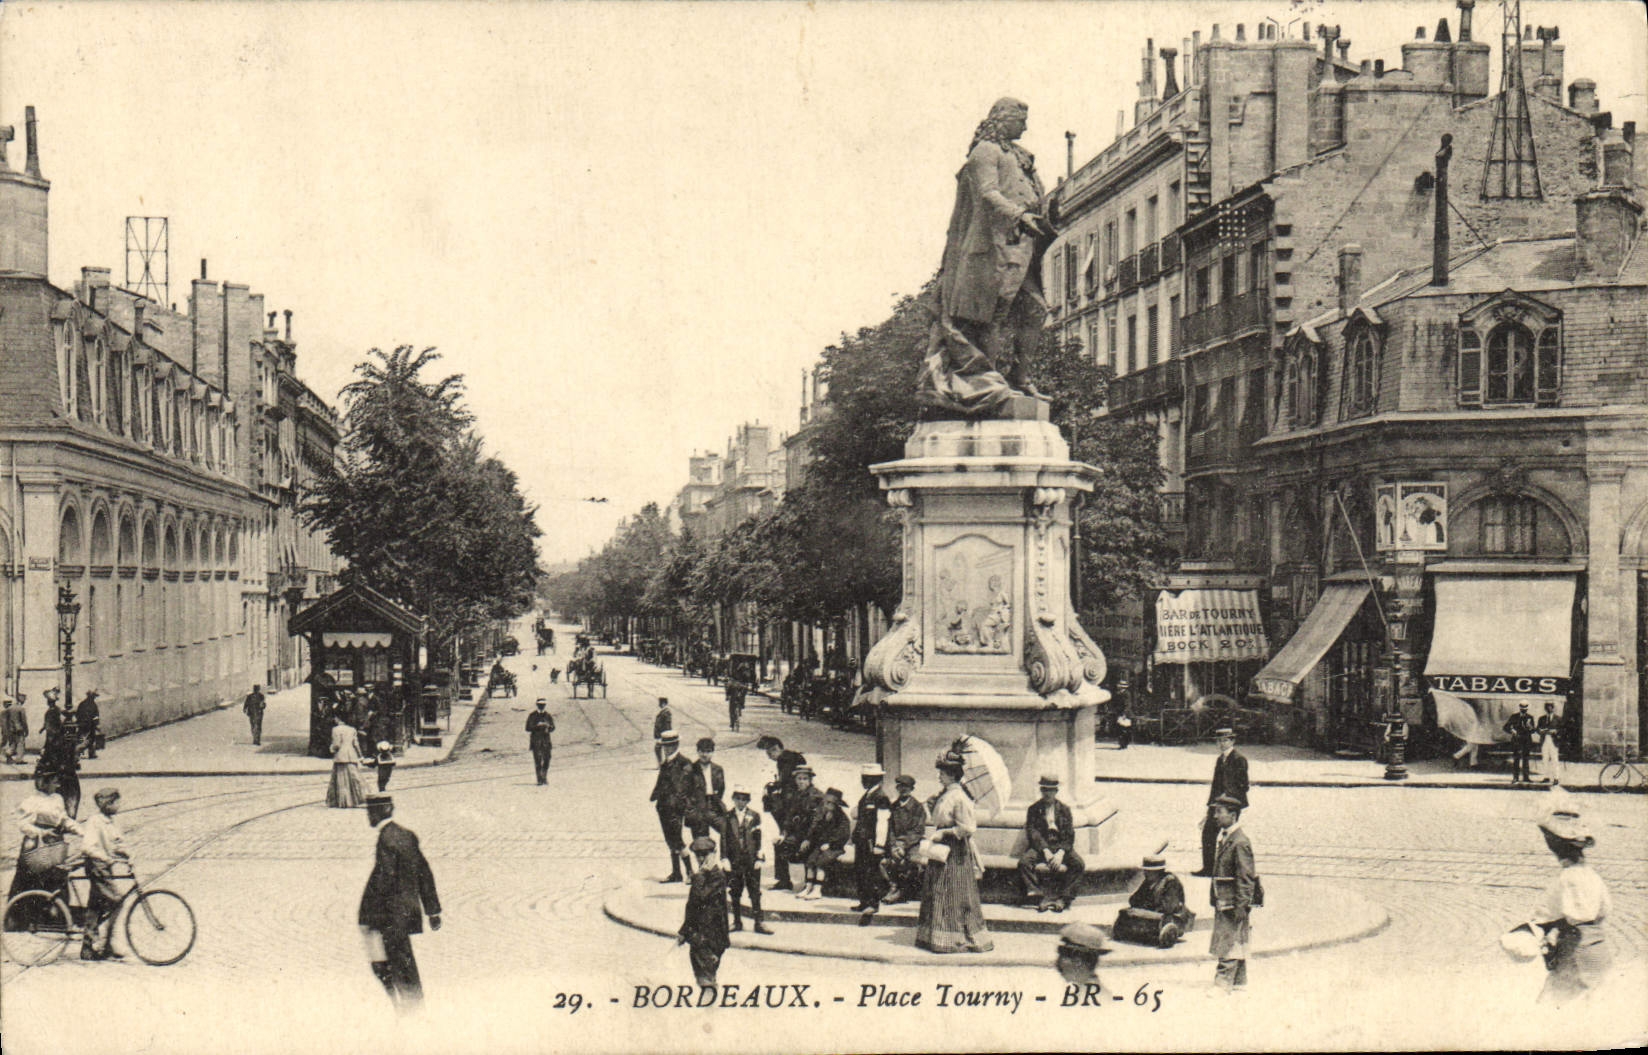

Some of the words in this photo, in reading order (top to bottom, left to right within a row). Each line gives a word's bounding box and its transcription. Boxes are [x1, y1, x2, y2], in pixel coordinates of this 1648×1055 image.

[1162, 608, 1188, 620] BAR
[1201, 607, 1255, 620] TOURNY
[1167, 639, 1209, 651] BOCK
[1434, 676, 1558, 693] TABACS
